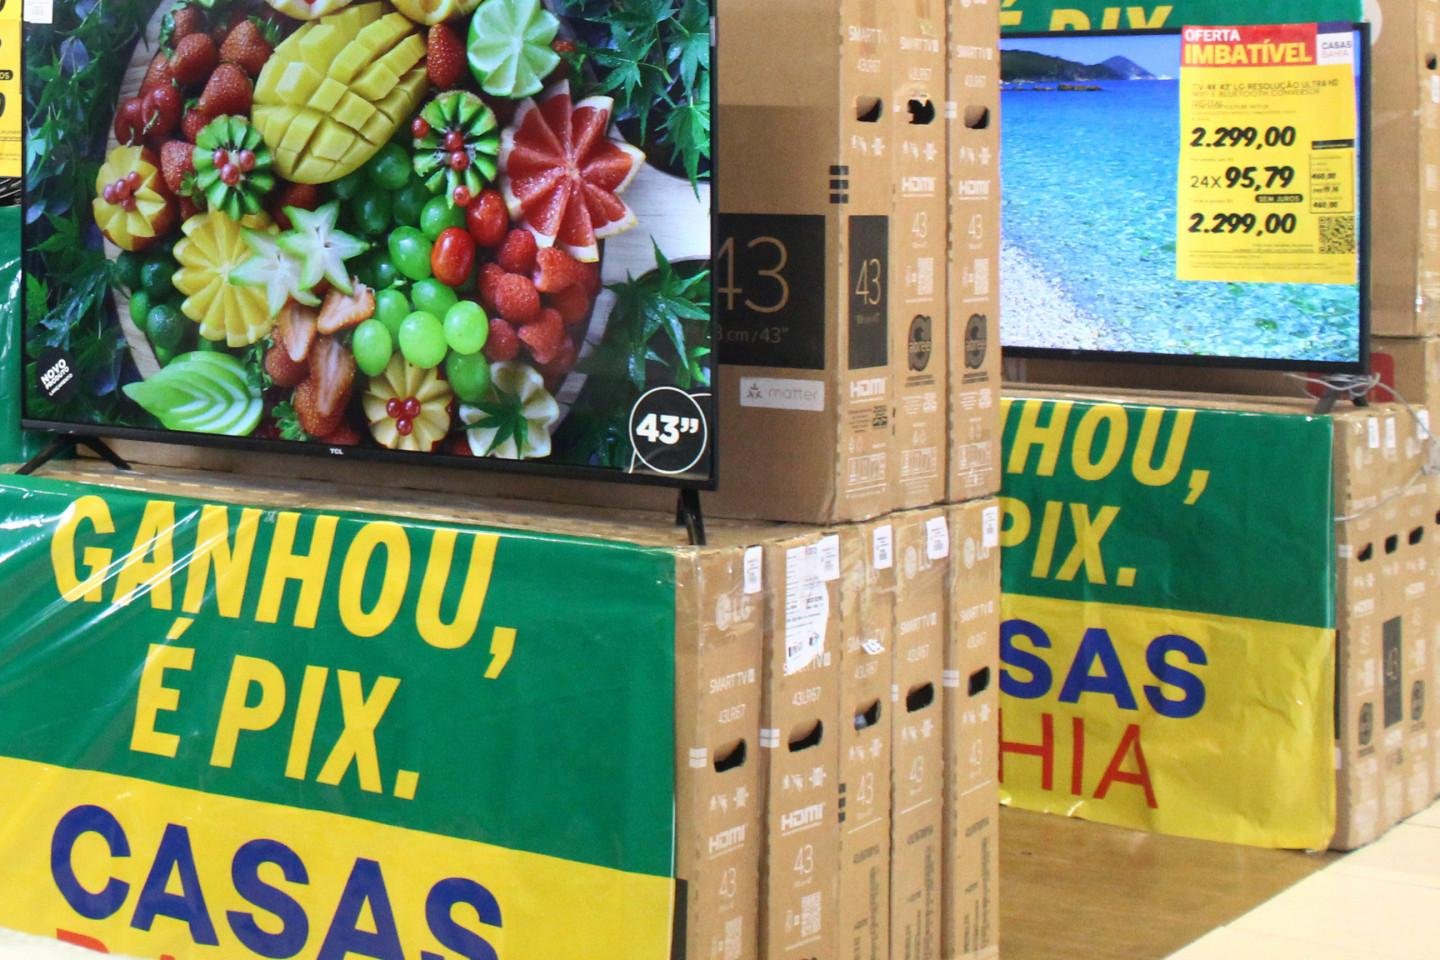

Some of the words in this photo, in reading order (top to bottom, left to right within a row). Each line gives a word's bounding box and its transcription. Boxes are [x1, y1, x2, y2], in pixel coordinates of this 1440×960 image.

[1184, 28, 1241, 43] OFERTA
[1321, 41, 1352, 51] CASAS
[1184, 39, 1313, 65] IMBATÍVEL
[1247, 80, 1300, 91] RESOLUÇÃO
[1301, 79, 1327, 89] ULTRA
[1189, 125, 1297, 151] 2.299,00
[901, 176, 936, 192] HDMI
[959, 180, 991, 196] HDMI
[1224, 165, 1296, 192] 95,79
[1275, 194, 1301, 203] JUROS
[911, 211, 928, 239] 43
[968, 213, 983, 240] 43
[1187, 212, 1297, 237] 2.299,00
[854, 258, 882, 306] 43
[40, 358, 67, 390] NOVO
[849, 377, 887, 398] HDMI
[768, 386, 817, 401] matter
[1000, 399, 1210, 506] HOU,
[50, 493, 518, 680] GANHOU,
[129, 617, 195, 758] É
[209, 654, 421, 801] PIX.
[969, 739, 983, 766] 43
[909, 755, 924, 783] 43
[856, 772, 875, 804] 43
[780, 803, 825, 832] HDMI
[708, 823, 747, 855] HDMI
[793, 844, 814, 875] 43
[50, 804, 505, 960] CASAS
[719, 867, 737, 898] 43
